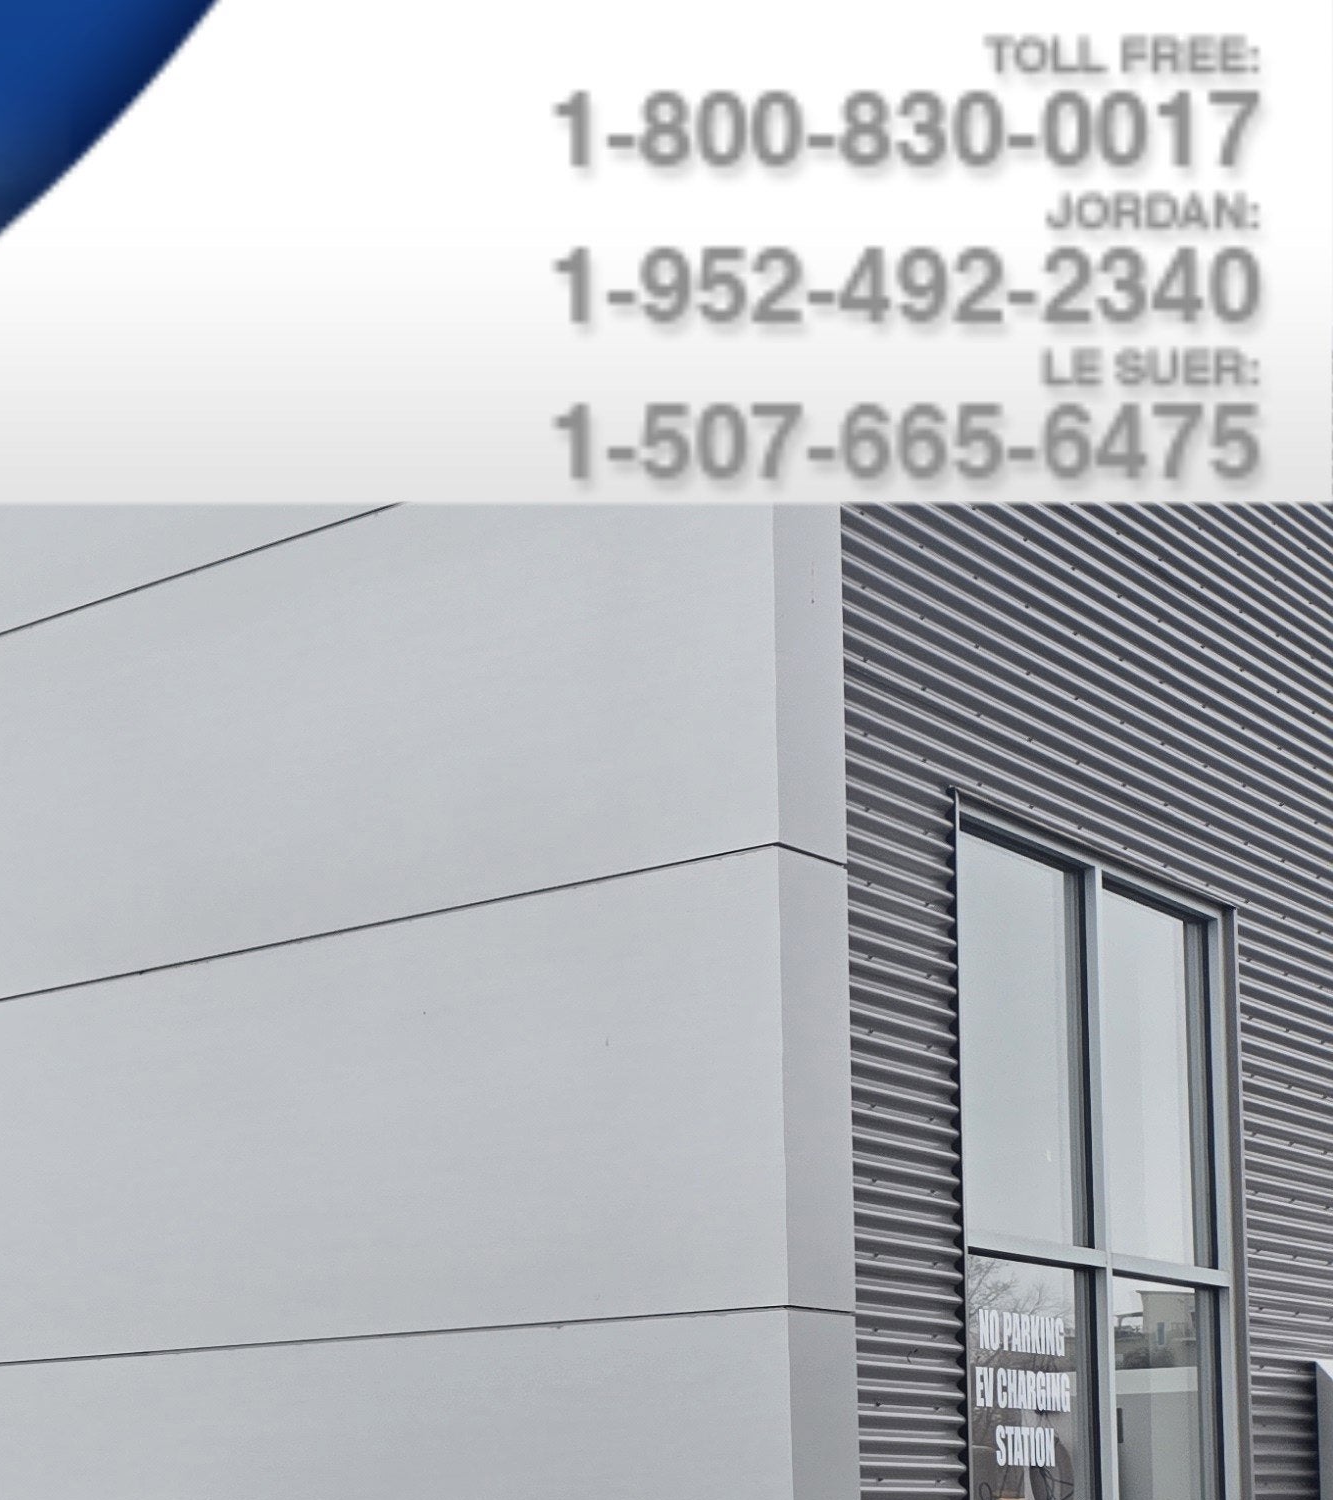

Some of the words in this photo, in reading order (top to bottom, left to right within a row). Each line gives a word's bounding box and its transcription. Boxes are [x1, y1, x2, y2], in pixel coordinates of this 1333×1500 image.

[978, 1309, 1000, 1351] NO
[1002, 1311, 1066, 1357] PARKING
[975, 1366, 994, 1408] EV
[996, 1367, 1071, 1413] CHARGING
[995, 1424, 1056, 1468] STATION
